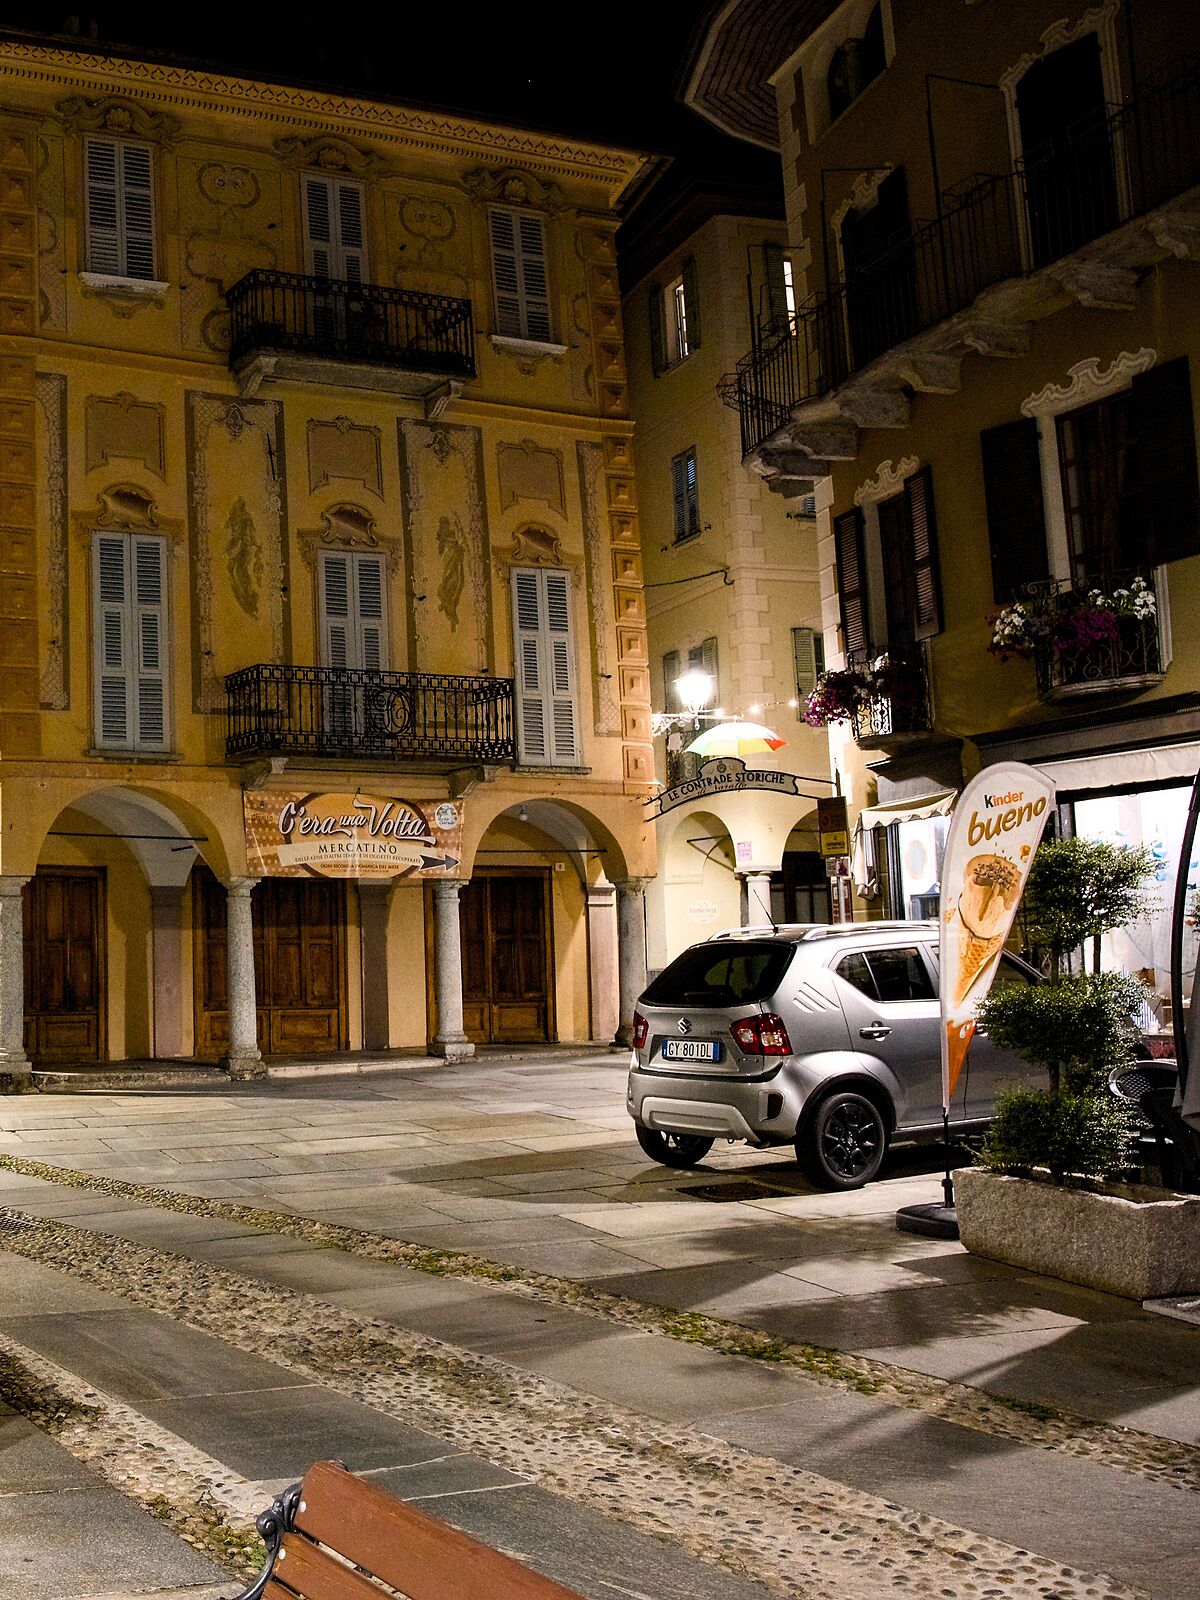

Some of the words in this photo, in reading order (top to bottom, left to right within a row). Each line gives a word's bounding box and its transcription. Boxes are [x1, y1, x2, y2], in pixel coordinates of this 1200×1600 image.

[667, 789, 680, 802] LE
[680, 773, 732, 795] CONTRADE
[735, 772, 785, 784] STORICHE
[278, 801, 353, 838] C'era
[339, 814, 368, 827] una
[352, 798, 437, 845] Volta
[968, 796, 1047, 847] bueno
[318, 843, 397, 855] MERCATINO
[682, 1043, 712, 1058] 801DL
